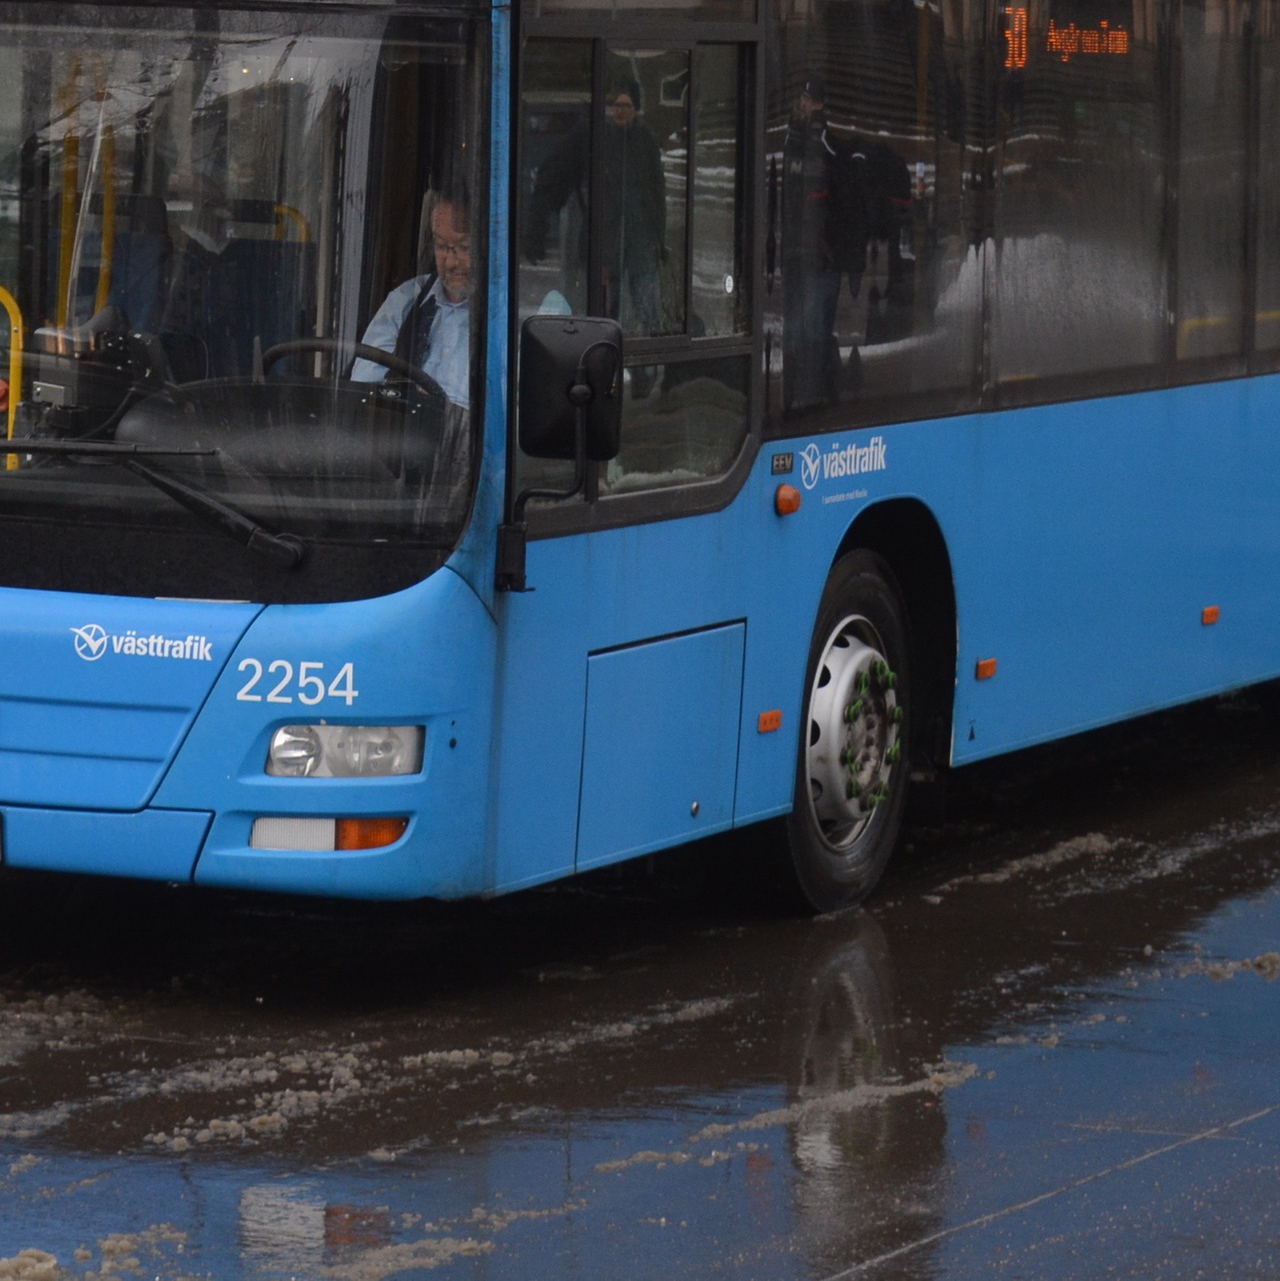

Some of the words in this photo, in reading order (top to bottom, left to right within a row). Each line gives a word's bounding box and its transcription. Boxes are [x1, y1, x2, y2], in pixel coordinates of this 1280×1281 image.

[772, 454, 794, 470] EEV
[823, 435, 887, 479] västtrafik
[111, 630, 213, 661] västtrafik
[236, 657, 360, 706] 2254
